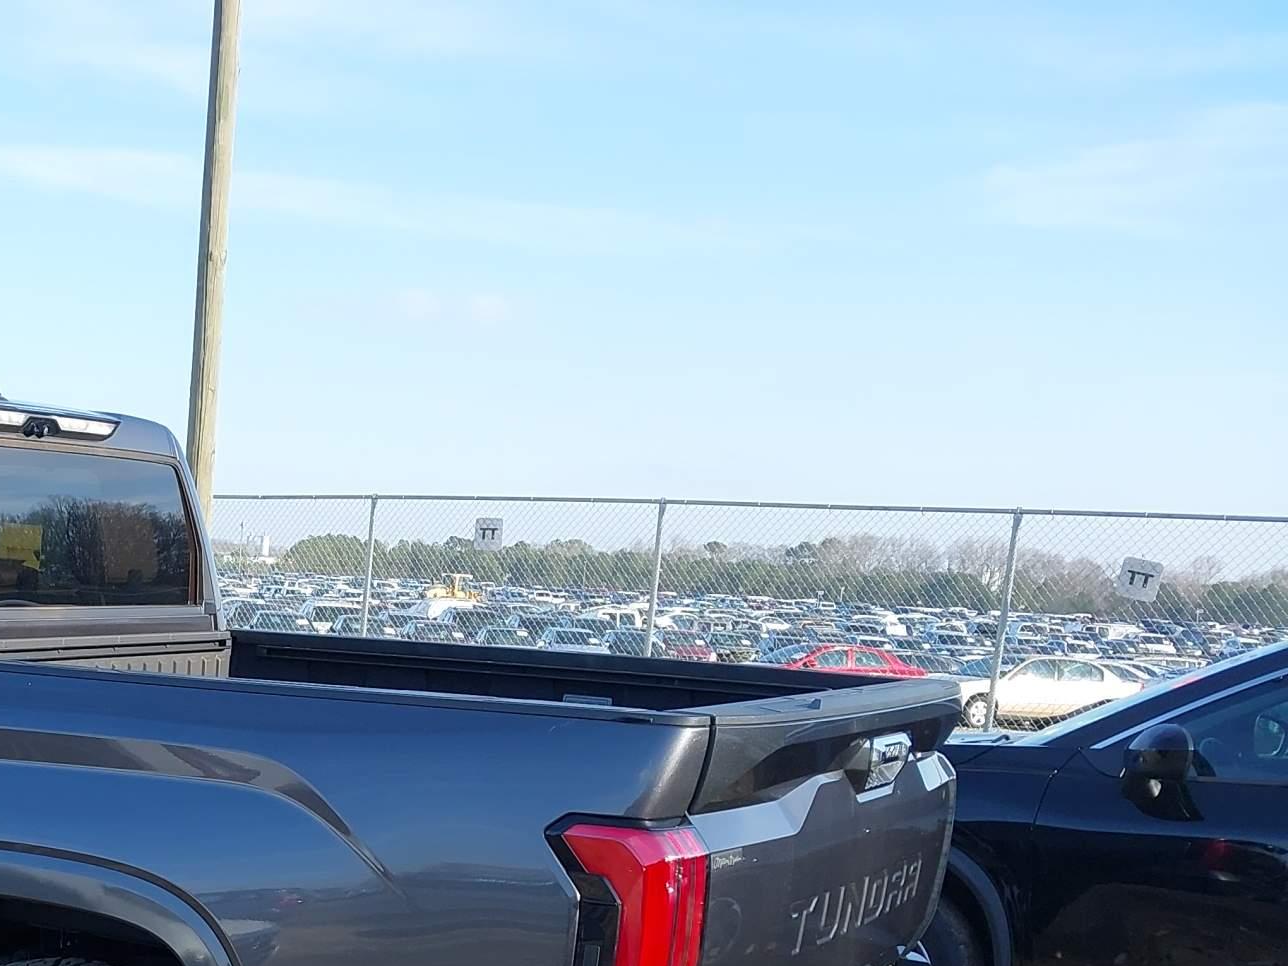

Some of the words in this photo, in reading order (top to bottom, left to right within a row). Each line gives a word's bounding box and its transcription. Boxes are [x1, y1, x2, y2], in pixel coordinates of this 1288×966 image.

[480, 527, 498, 540] TT
[1127, 569, 1155, 589] TT
[791, 853, 923, 955] TUNDRA
